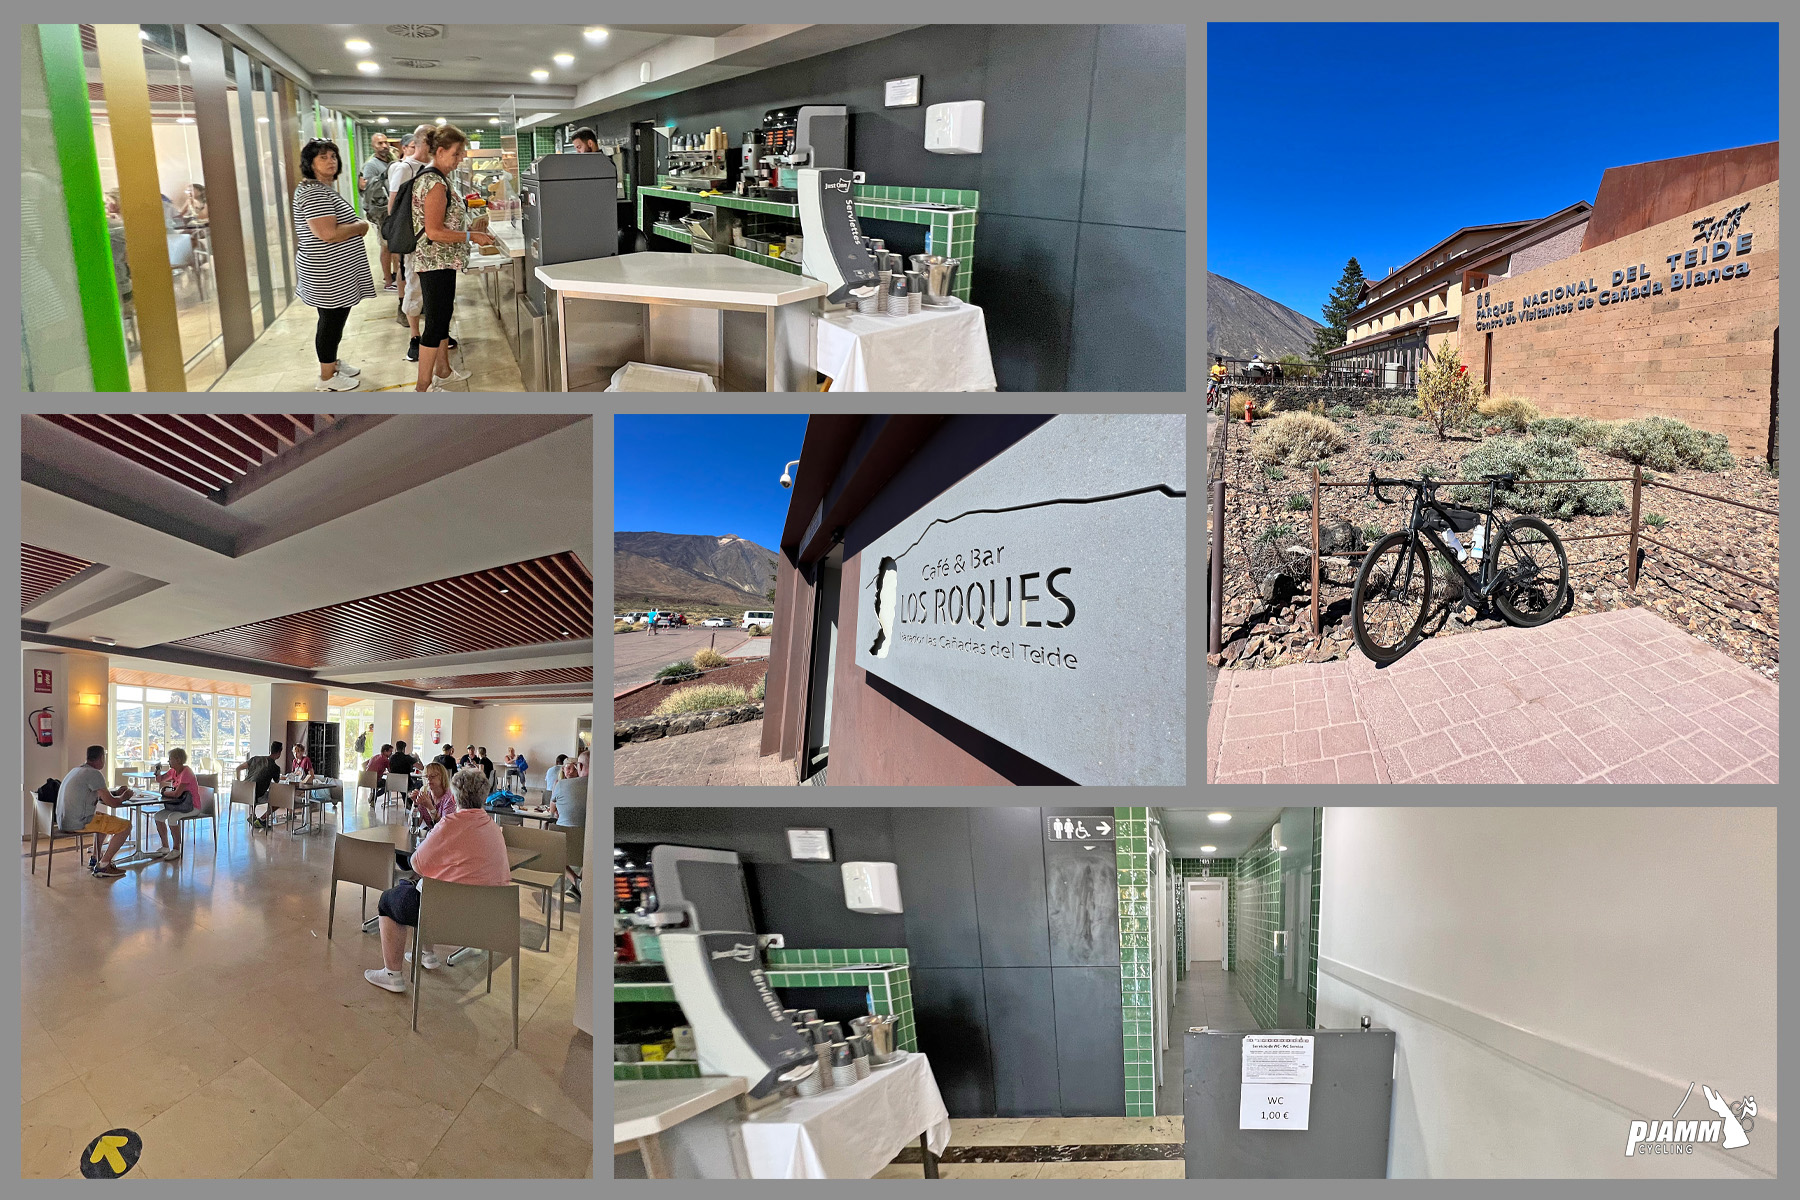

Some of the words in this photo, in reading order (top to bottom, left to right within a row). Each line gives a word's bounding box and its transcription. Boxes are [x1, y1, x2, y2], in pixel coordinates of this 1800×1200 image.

[845, 199, 862, 246] Serviettes
[1476, 301, 1515, 321] PARQUE
[1523, 278, 1598, 309] NACIONAL
[1612, 263, 1651, 287] DEL
[1667, 232, 1753, 273] TEIDE
[1476, 319, 1504, 332] Centro
[1505, 313, 1517, 326] de
[1518, 302, 1574, 324] Visitantes
[1577, 295, 1594, 312] de
[1599, 280, 1663, 306] Cañada
[1670, 261, 1751, 292] Blanca
[922, 558, 950, 581] Café
[953, 554, 966, 574] &
[970, 545, 1005, 570] Bar
[900, 591, 928, 624] LOS
[934, 567, 1076, 631] ROQUES
[939, 635, 986, 655] Cañadas
[990, 641, 1015, 661] del
[1019, 643, 1078, 670] Teide
[1261, 1111, 1281, 1120] 1,00
[1283, 1111, 1289, 1119] €
[1267, 1096, 1284, 1105] WC
